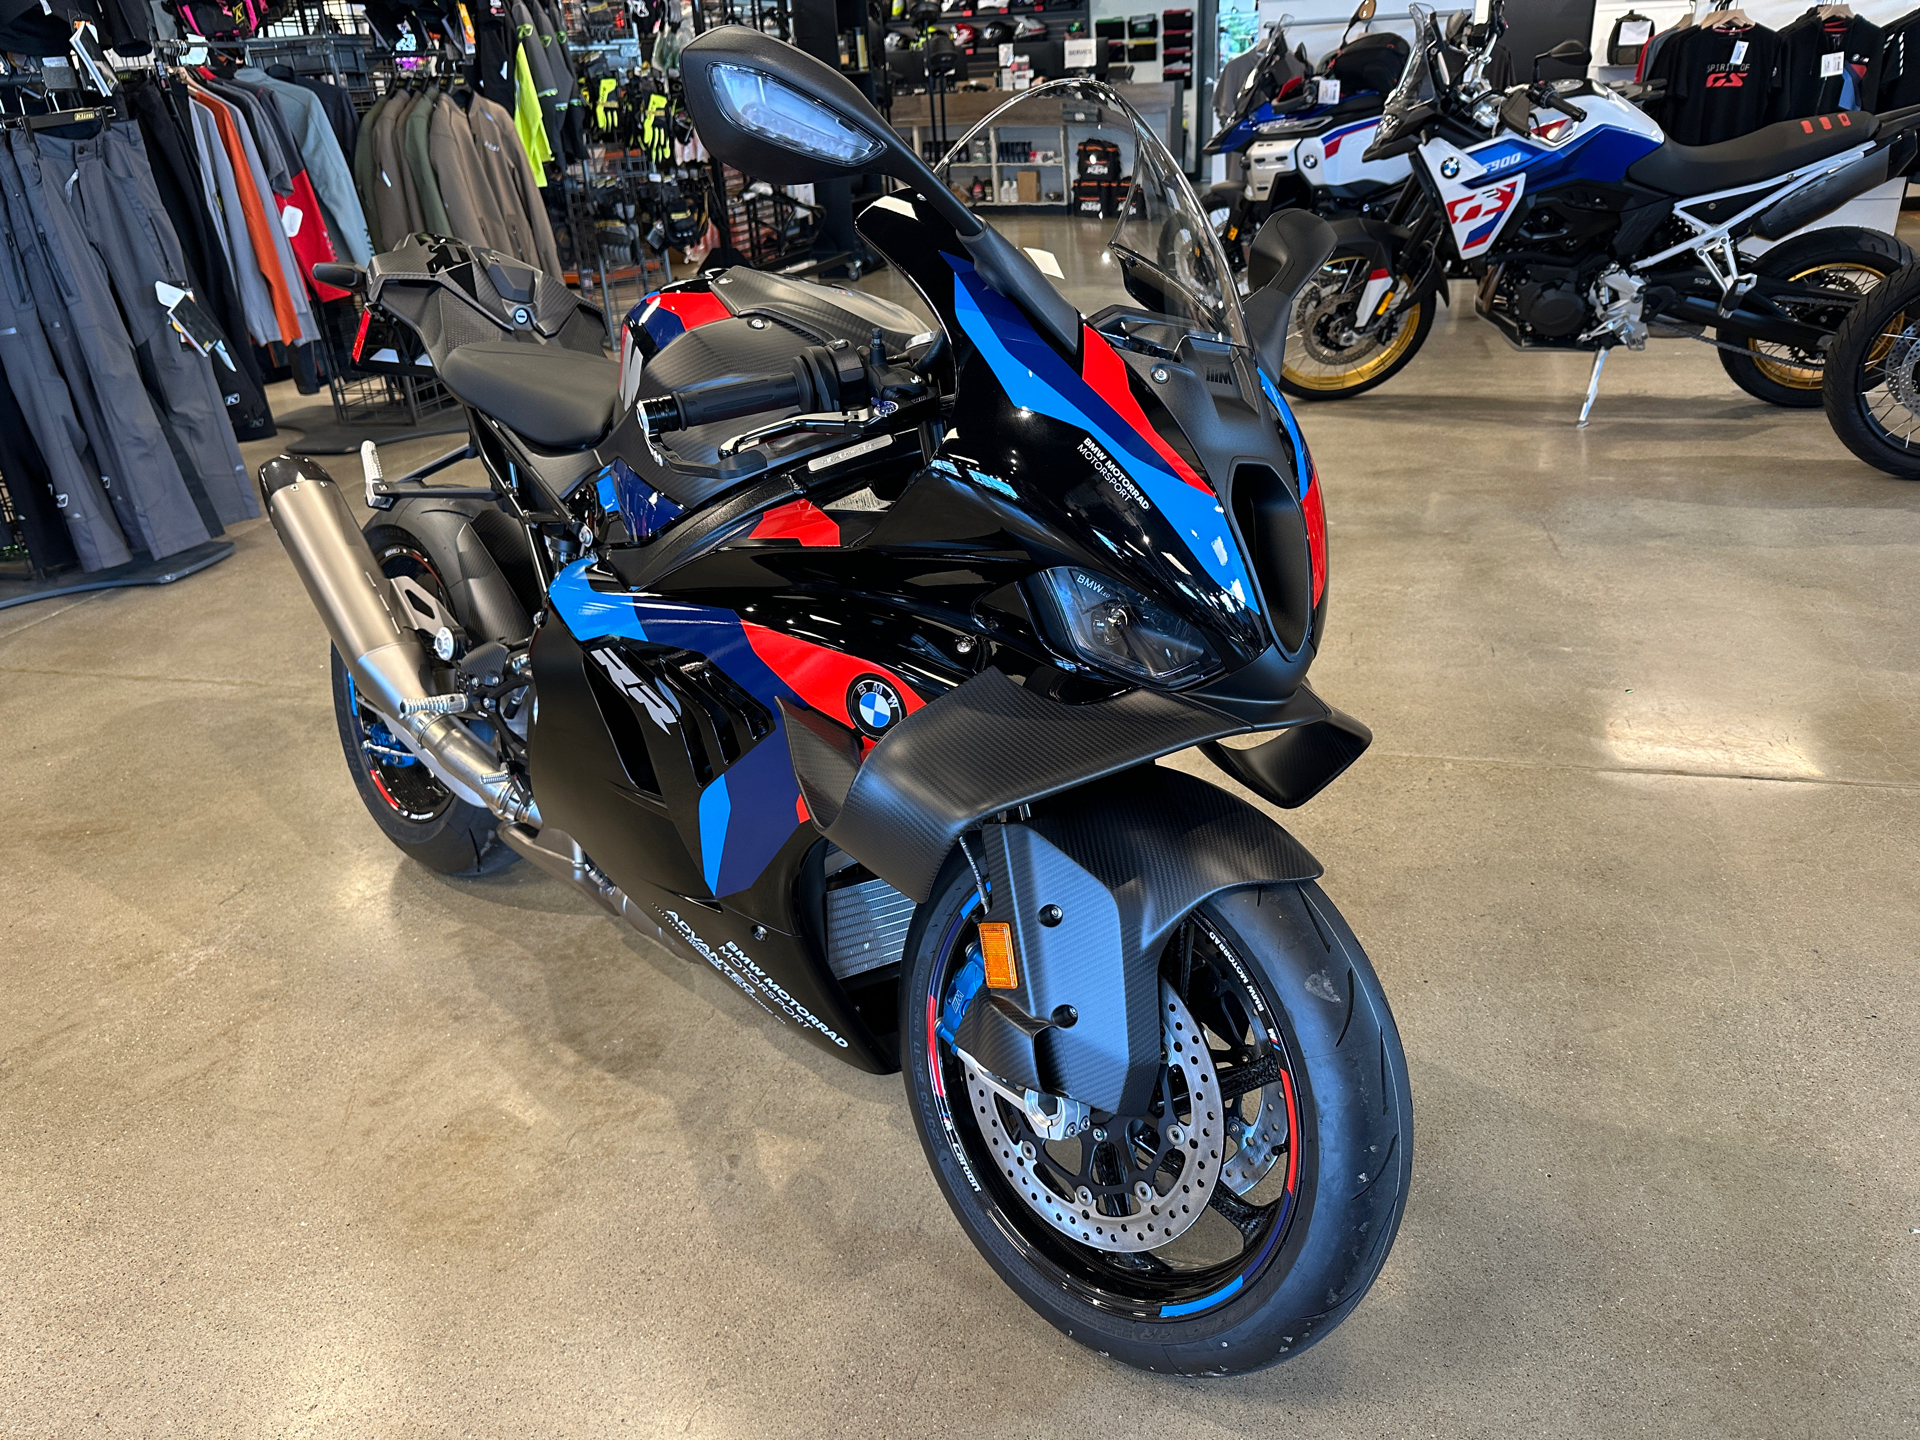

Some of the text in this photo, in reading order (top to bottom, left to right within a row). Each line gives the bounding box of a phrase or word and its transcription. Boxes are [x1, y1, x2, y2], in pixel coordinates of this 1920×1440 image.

[1706, 63, 1750, 73] SPIRIT OF
[1706, 72, 1748, 88] GS
[1086, 165, 1108, 175] KTM
[1081, 201, 1102, 211] KTM
[1077, 444, 1133, 501] MOTORSPORT
[1083, 437, 1149, 509] BMW MOTORRAD
[1077, 574, 1104, 593] BMW
[857, 682, 899, 708] BMW
[666, 910, 756, 993] ADVANTEC
[1209, 931, 1264, 1012] BMW MOTORRAD
[718, 945, 813, 1029] MOTORSPORT
[726, 940, 849, 1048] BMW MOTORRAD
[952, 1142, 982, 1192] Carbon
